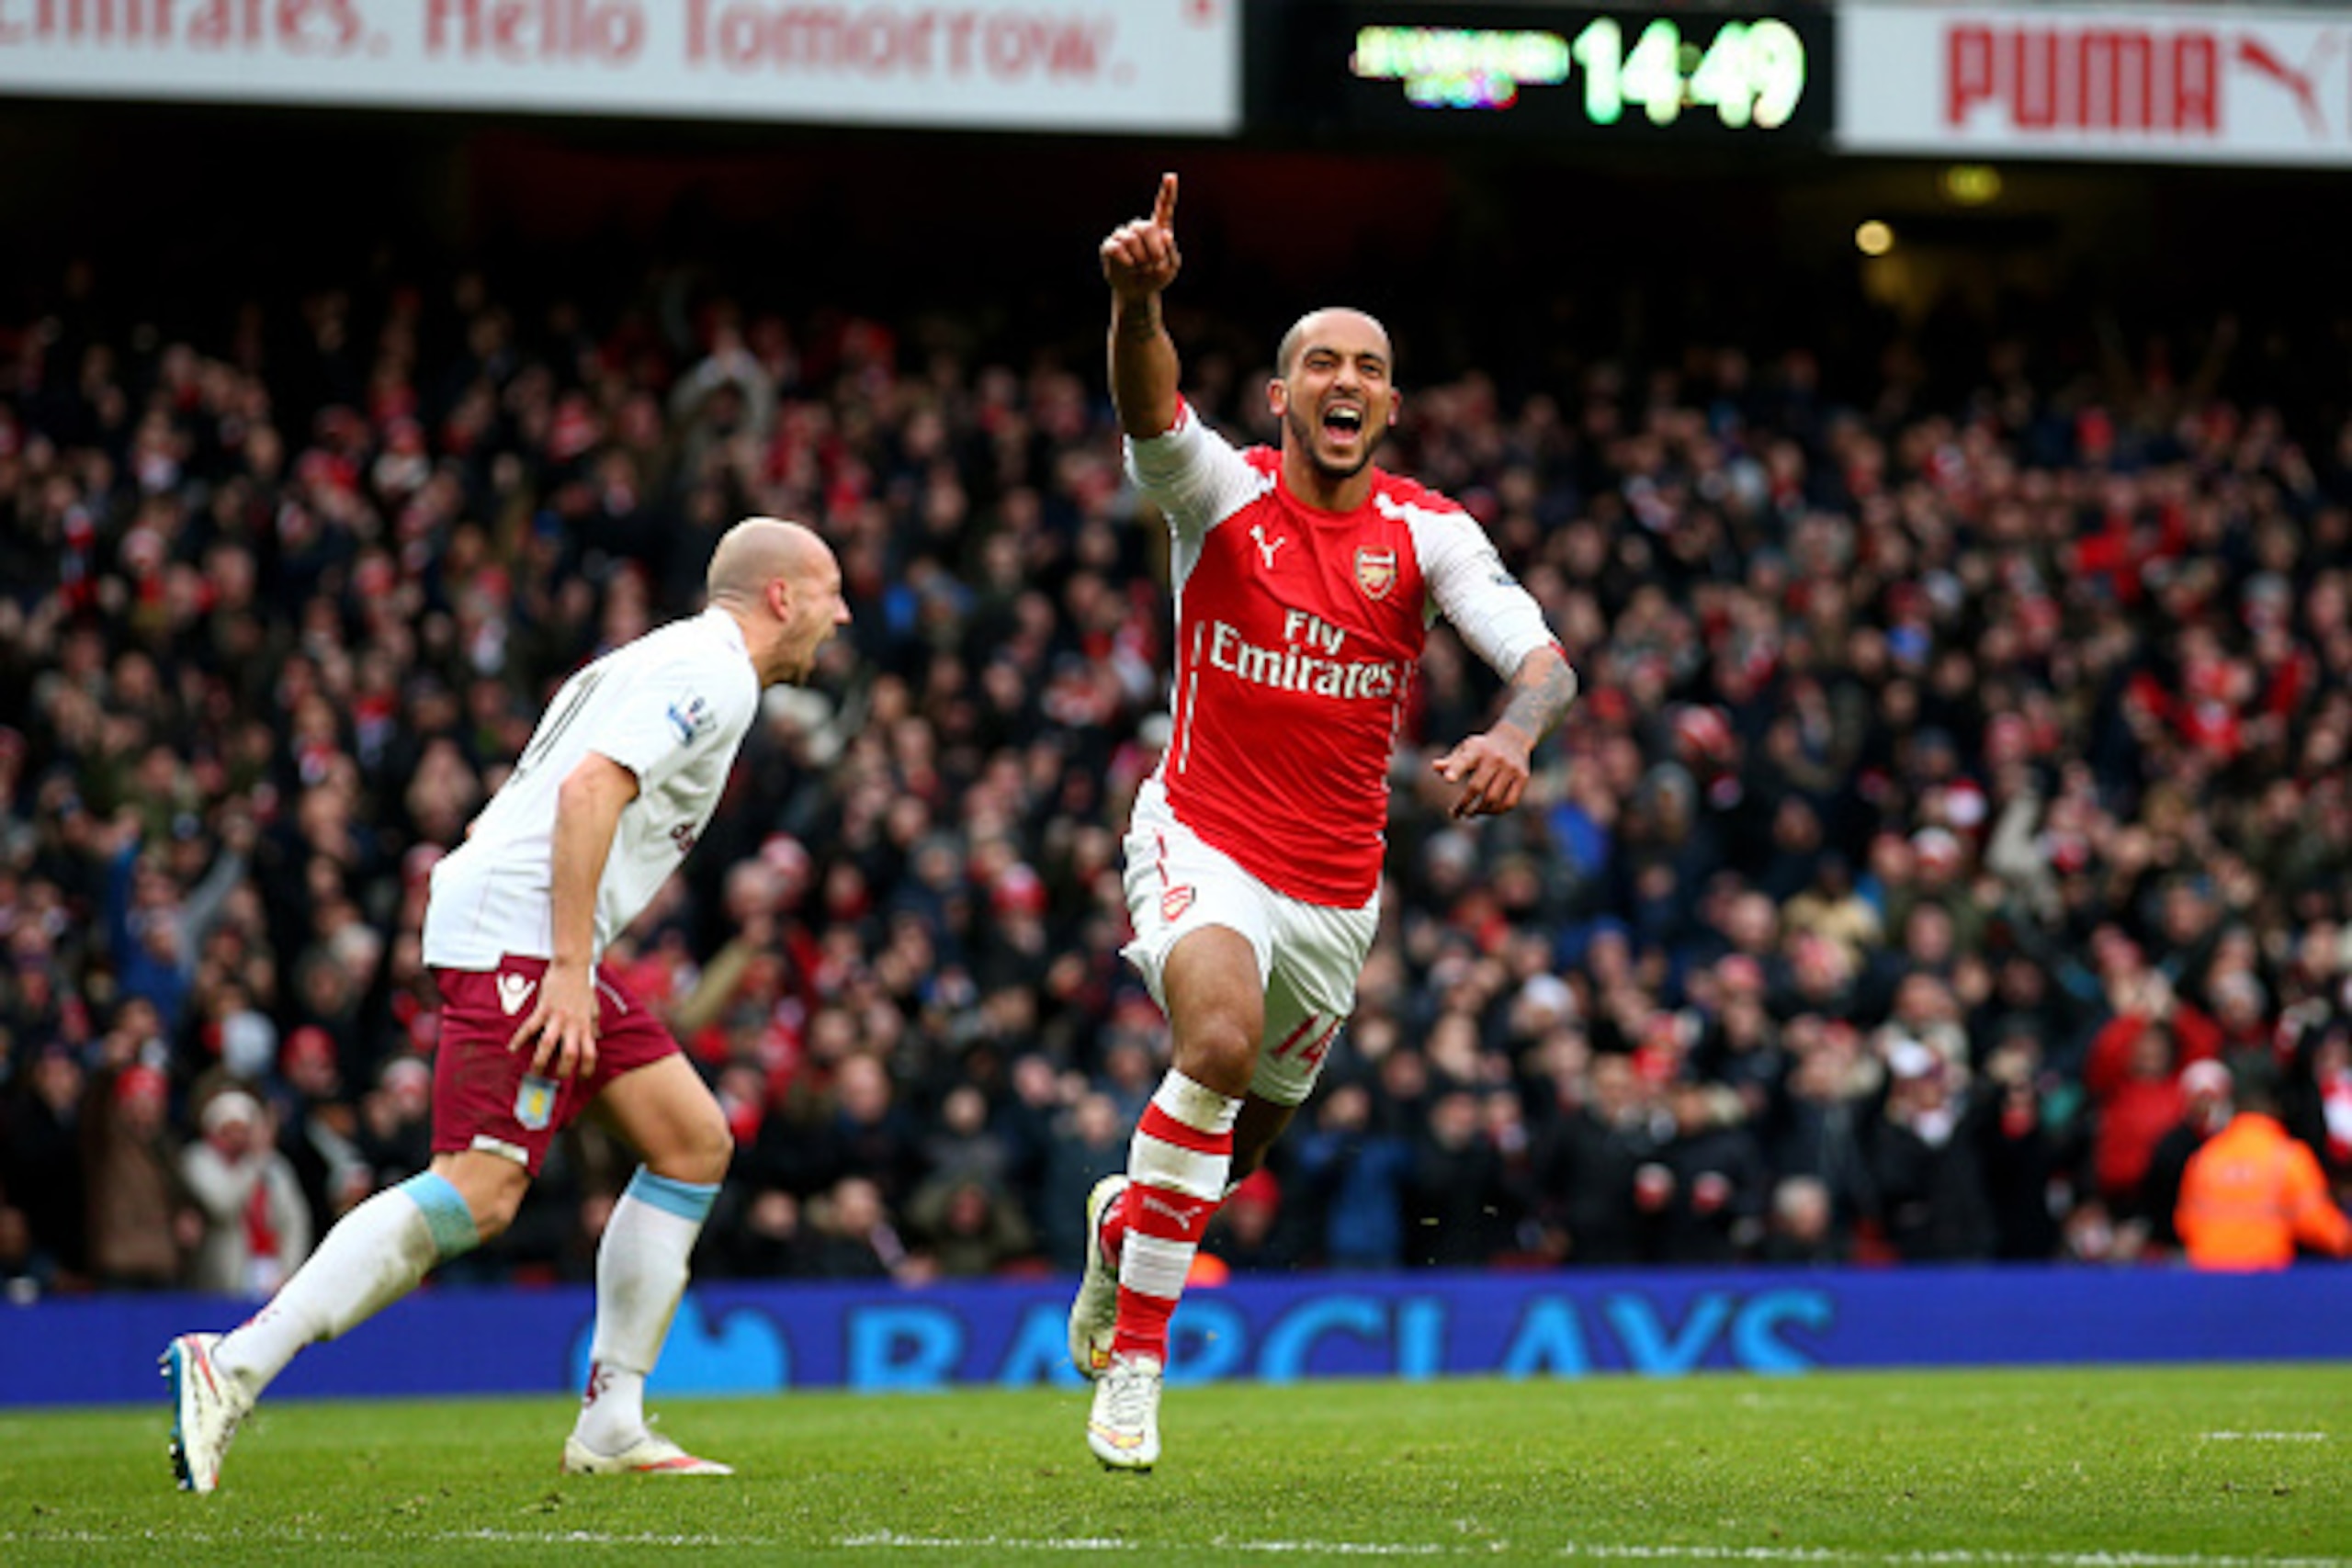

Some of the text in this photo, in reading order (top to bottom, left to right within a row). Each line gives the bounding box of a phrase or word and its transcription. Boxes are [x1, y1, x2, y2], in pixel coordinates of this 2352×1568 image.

[424, 0, 644, 67] Hello
[682, 0, 1137, 86] Tomorrow.
[1943, 26, 2222, 134] PUMA
[1210, 619, 1396, 699] Emirates
[1284, 608, 1347, 655] Fly
